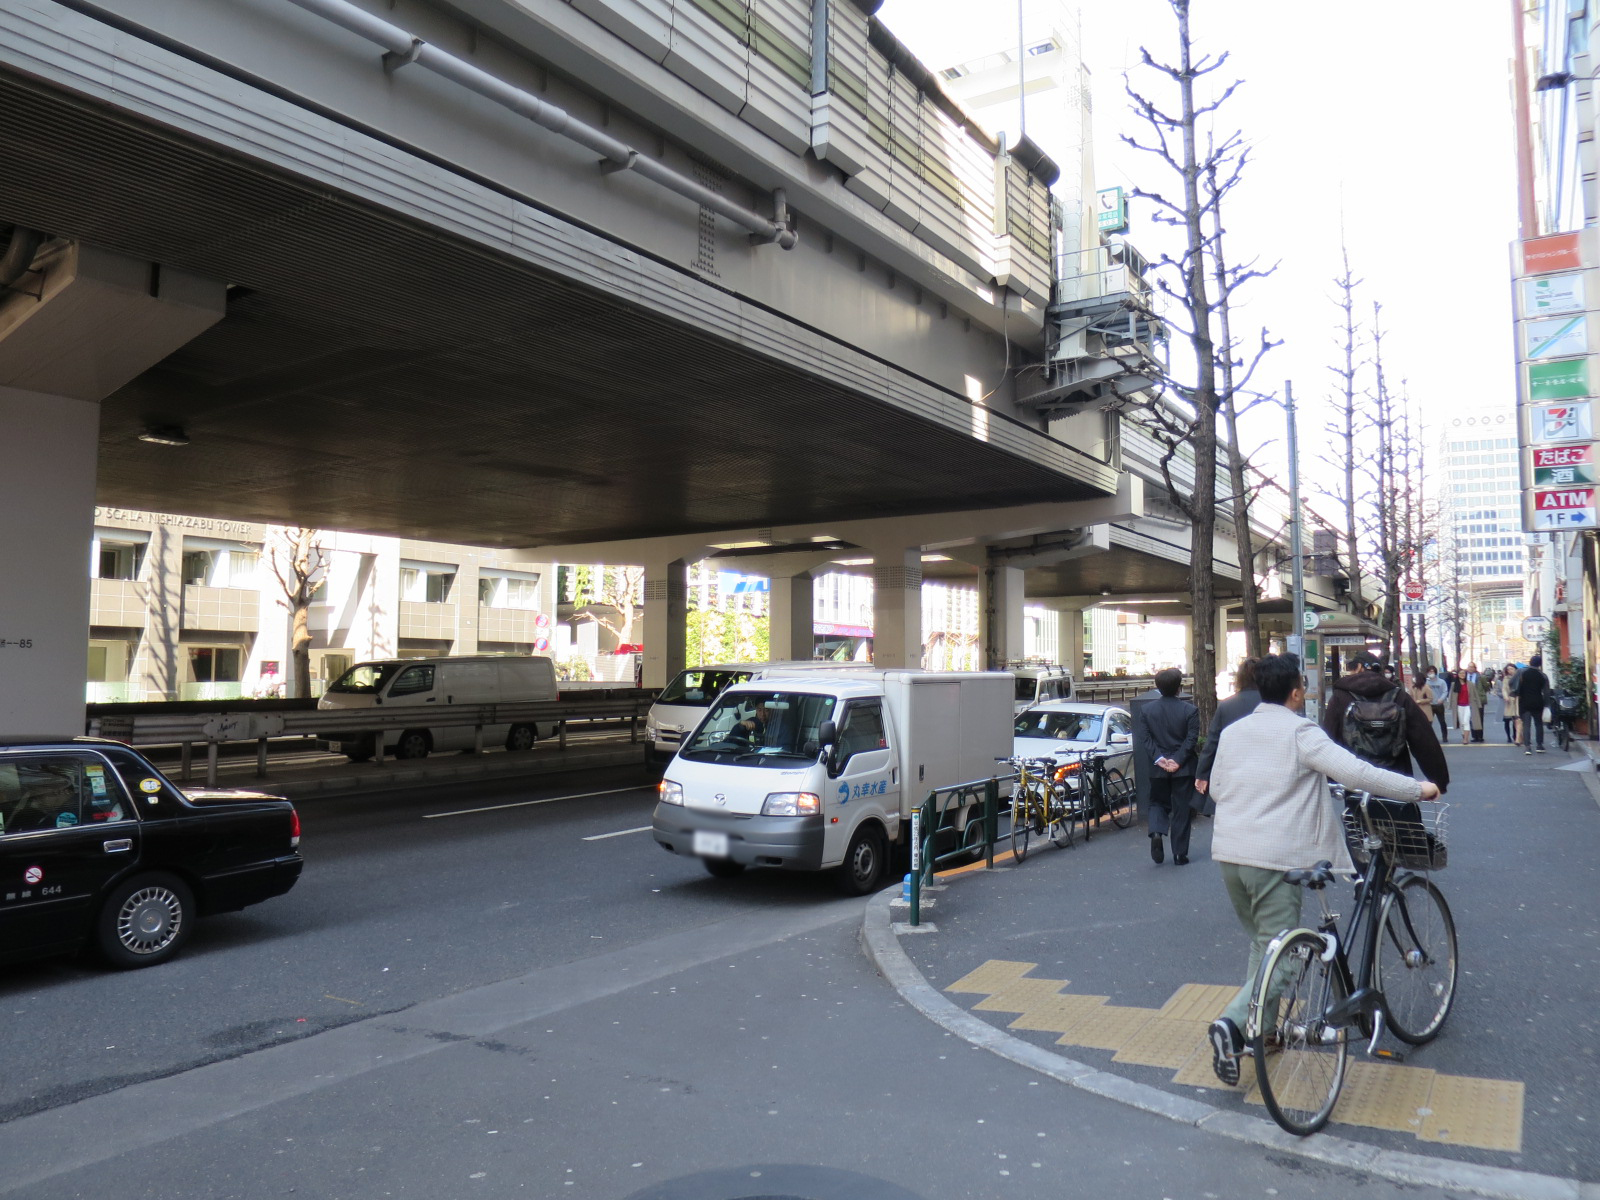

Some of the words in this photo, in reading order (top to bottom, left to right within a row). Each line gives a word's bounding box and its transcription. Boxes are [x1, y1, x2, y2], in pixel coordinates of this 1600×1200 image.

[1539, 448, 1586, 465] たばこ
[1551, 468, 1575, 483] 酒
[1542, 491, 1587, 507] ATM
[106, 508, 144, 523] SCALA
[149, 511, 213, 531] NISHIAZABU
[217, 520, 252, 535] TOWER
[1546, 513, 1565, 525] 1F
[851, 780, 888, 799] 丸幸水産
[41, 885, 62, 896] 644
